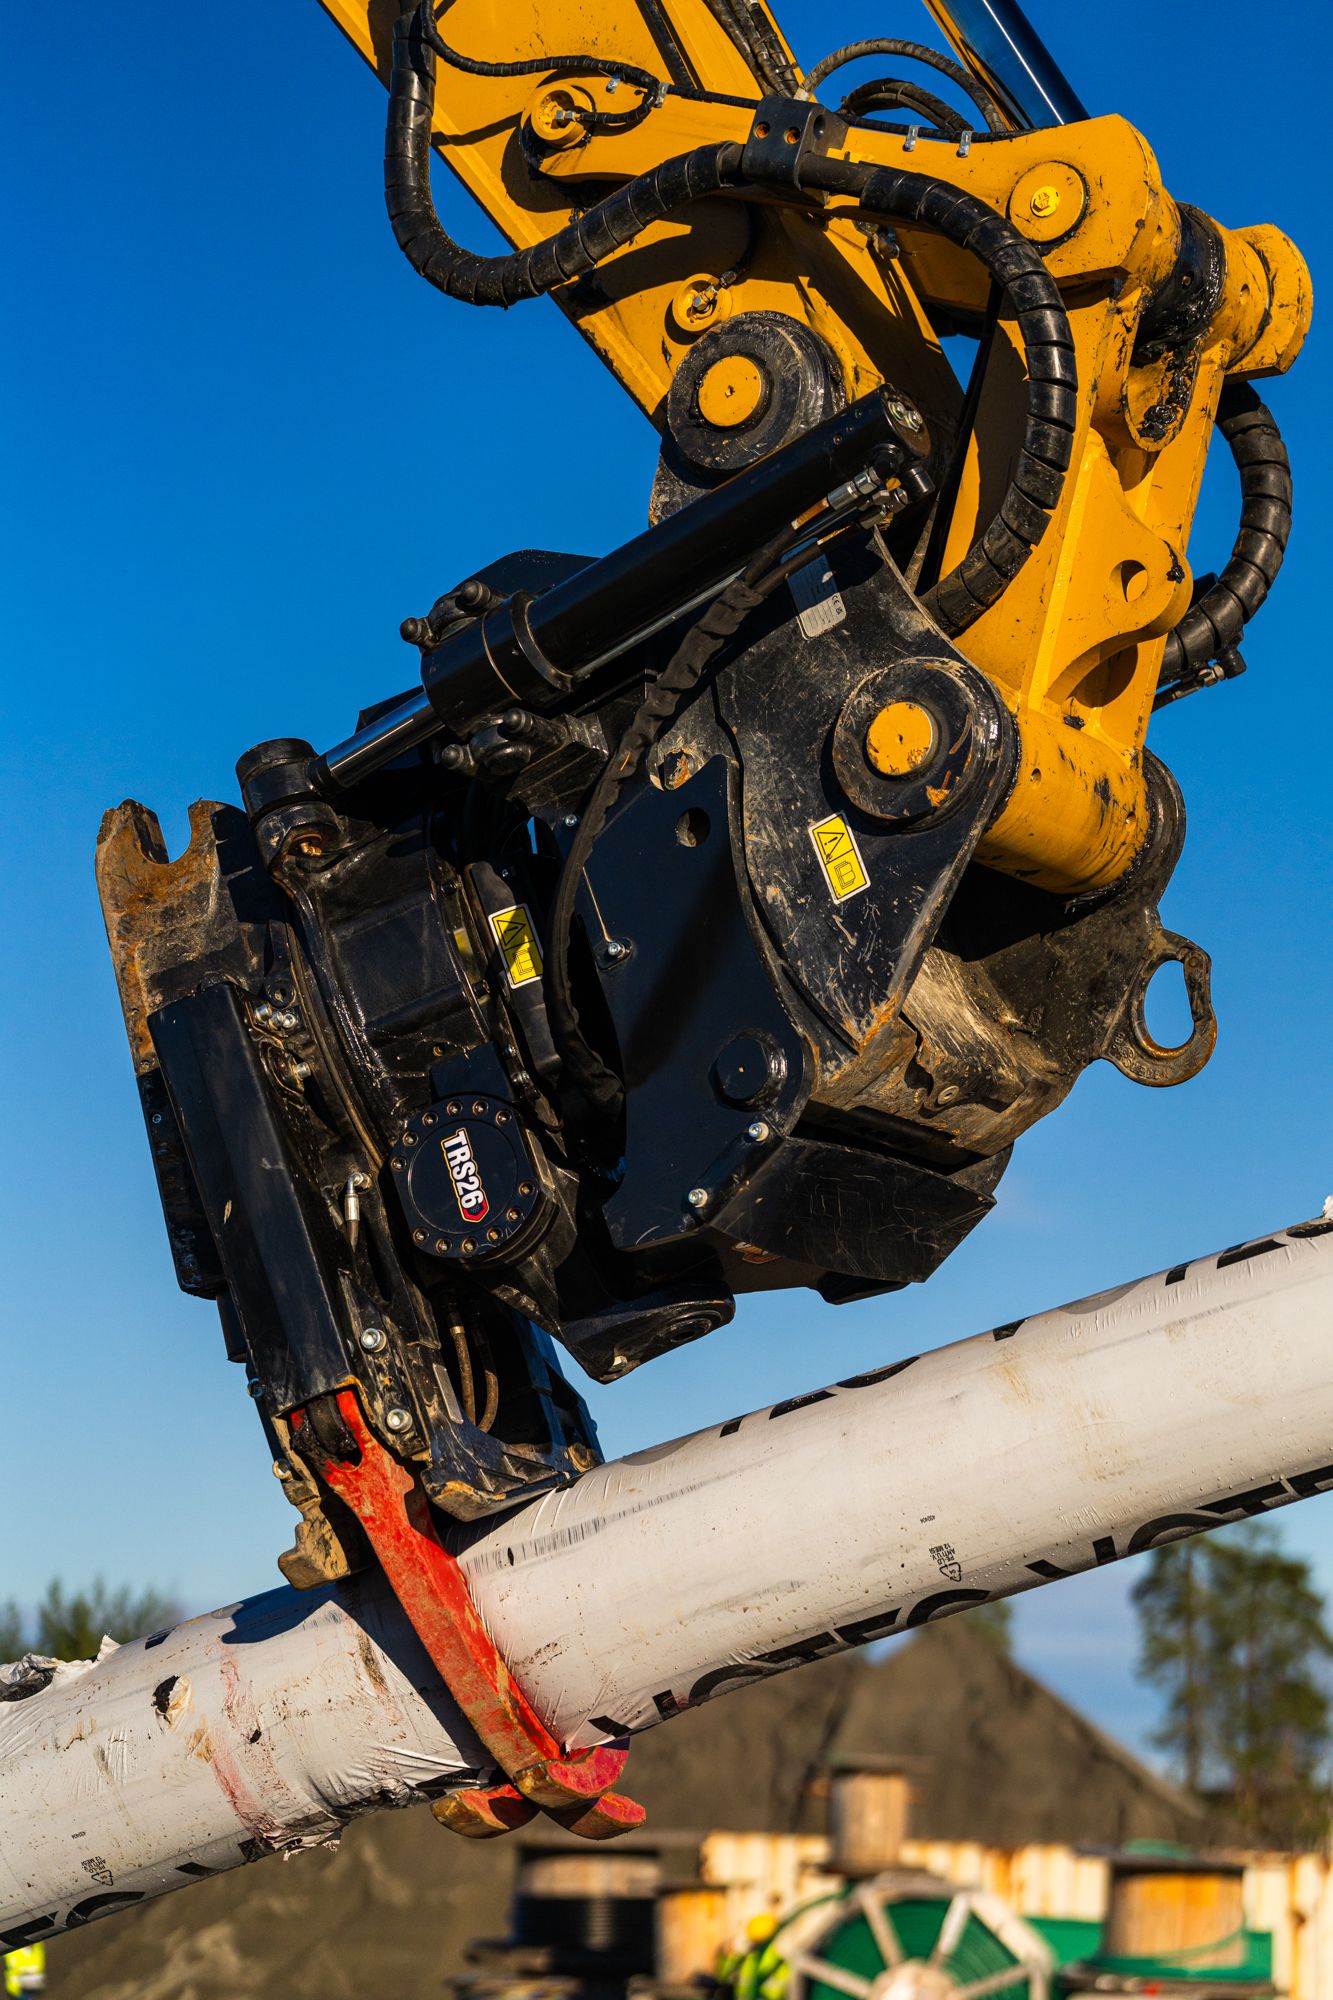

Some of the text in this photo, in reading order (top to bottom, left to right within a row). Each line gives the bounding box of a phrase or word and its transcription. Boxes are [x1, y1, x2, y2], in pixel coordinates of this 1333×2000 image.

[443, 1130, 484, 1209] TRS26
[929, 1545, 944, 1554] MESI
[942, 1548, 955, 1557] ANTI
